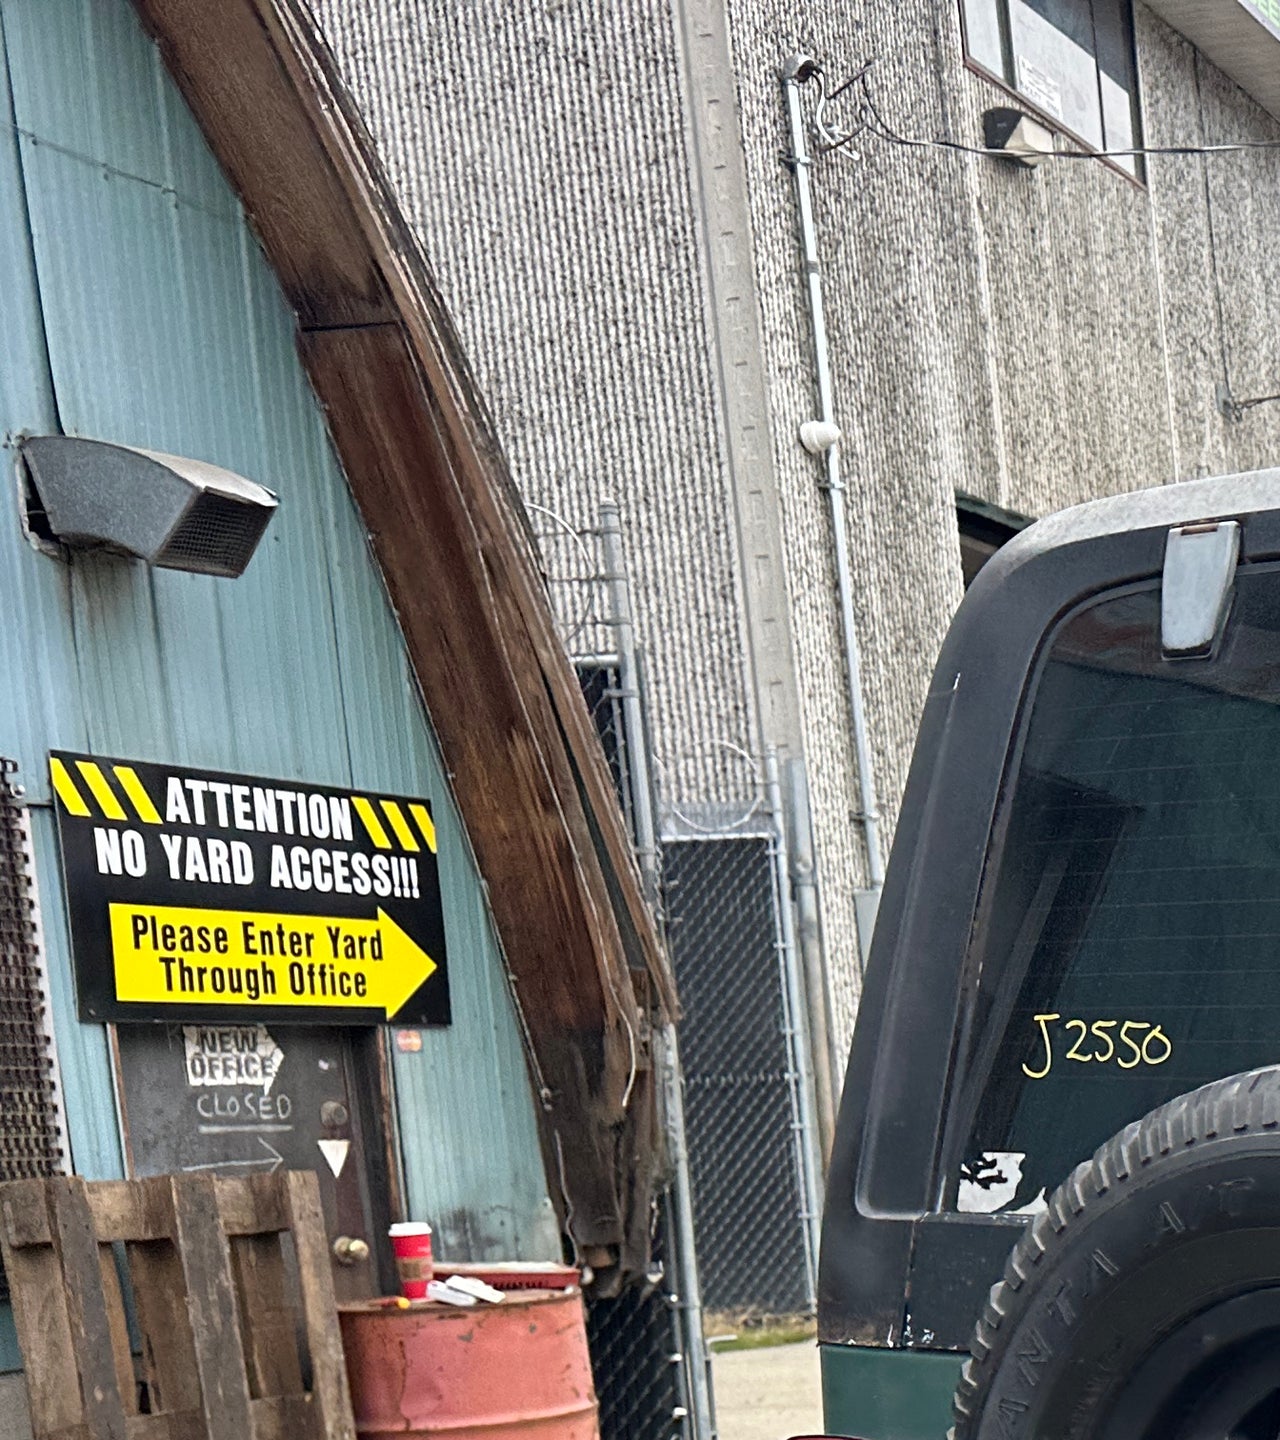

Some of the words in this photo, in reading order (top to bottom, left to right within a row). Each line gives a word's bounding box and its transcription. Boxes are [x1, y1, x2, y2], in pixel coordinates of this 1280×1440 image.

[166, 776, 354, 842] ATTENTION
[94, 827, 147, 878] NO
[160, 833, 254, 885] YARD
[270, 844, 421, 899] ACCESS!!!
[132, 914, 229, 955] Please
[242, 921, 314, 960] Enter
[325, 926, 385, 962] Yard
[159, 957, 277, 1000] Through
[288, 961, 368, 998] Office
[200, 1028, 258, 1054] NEW
[1021, 1013, 1172, 1079] J2550
[190, 1053, 276, 1080] OFFICE
[197, 1092, 292, 1120] CLOSED
